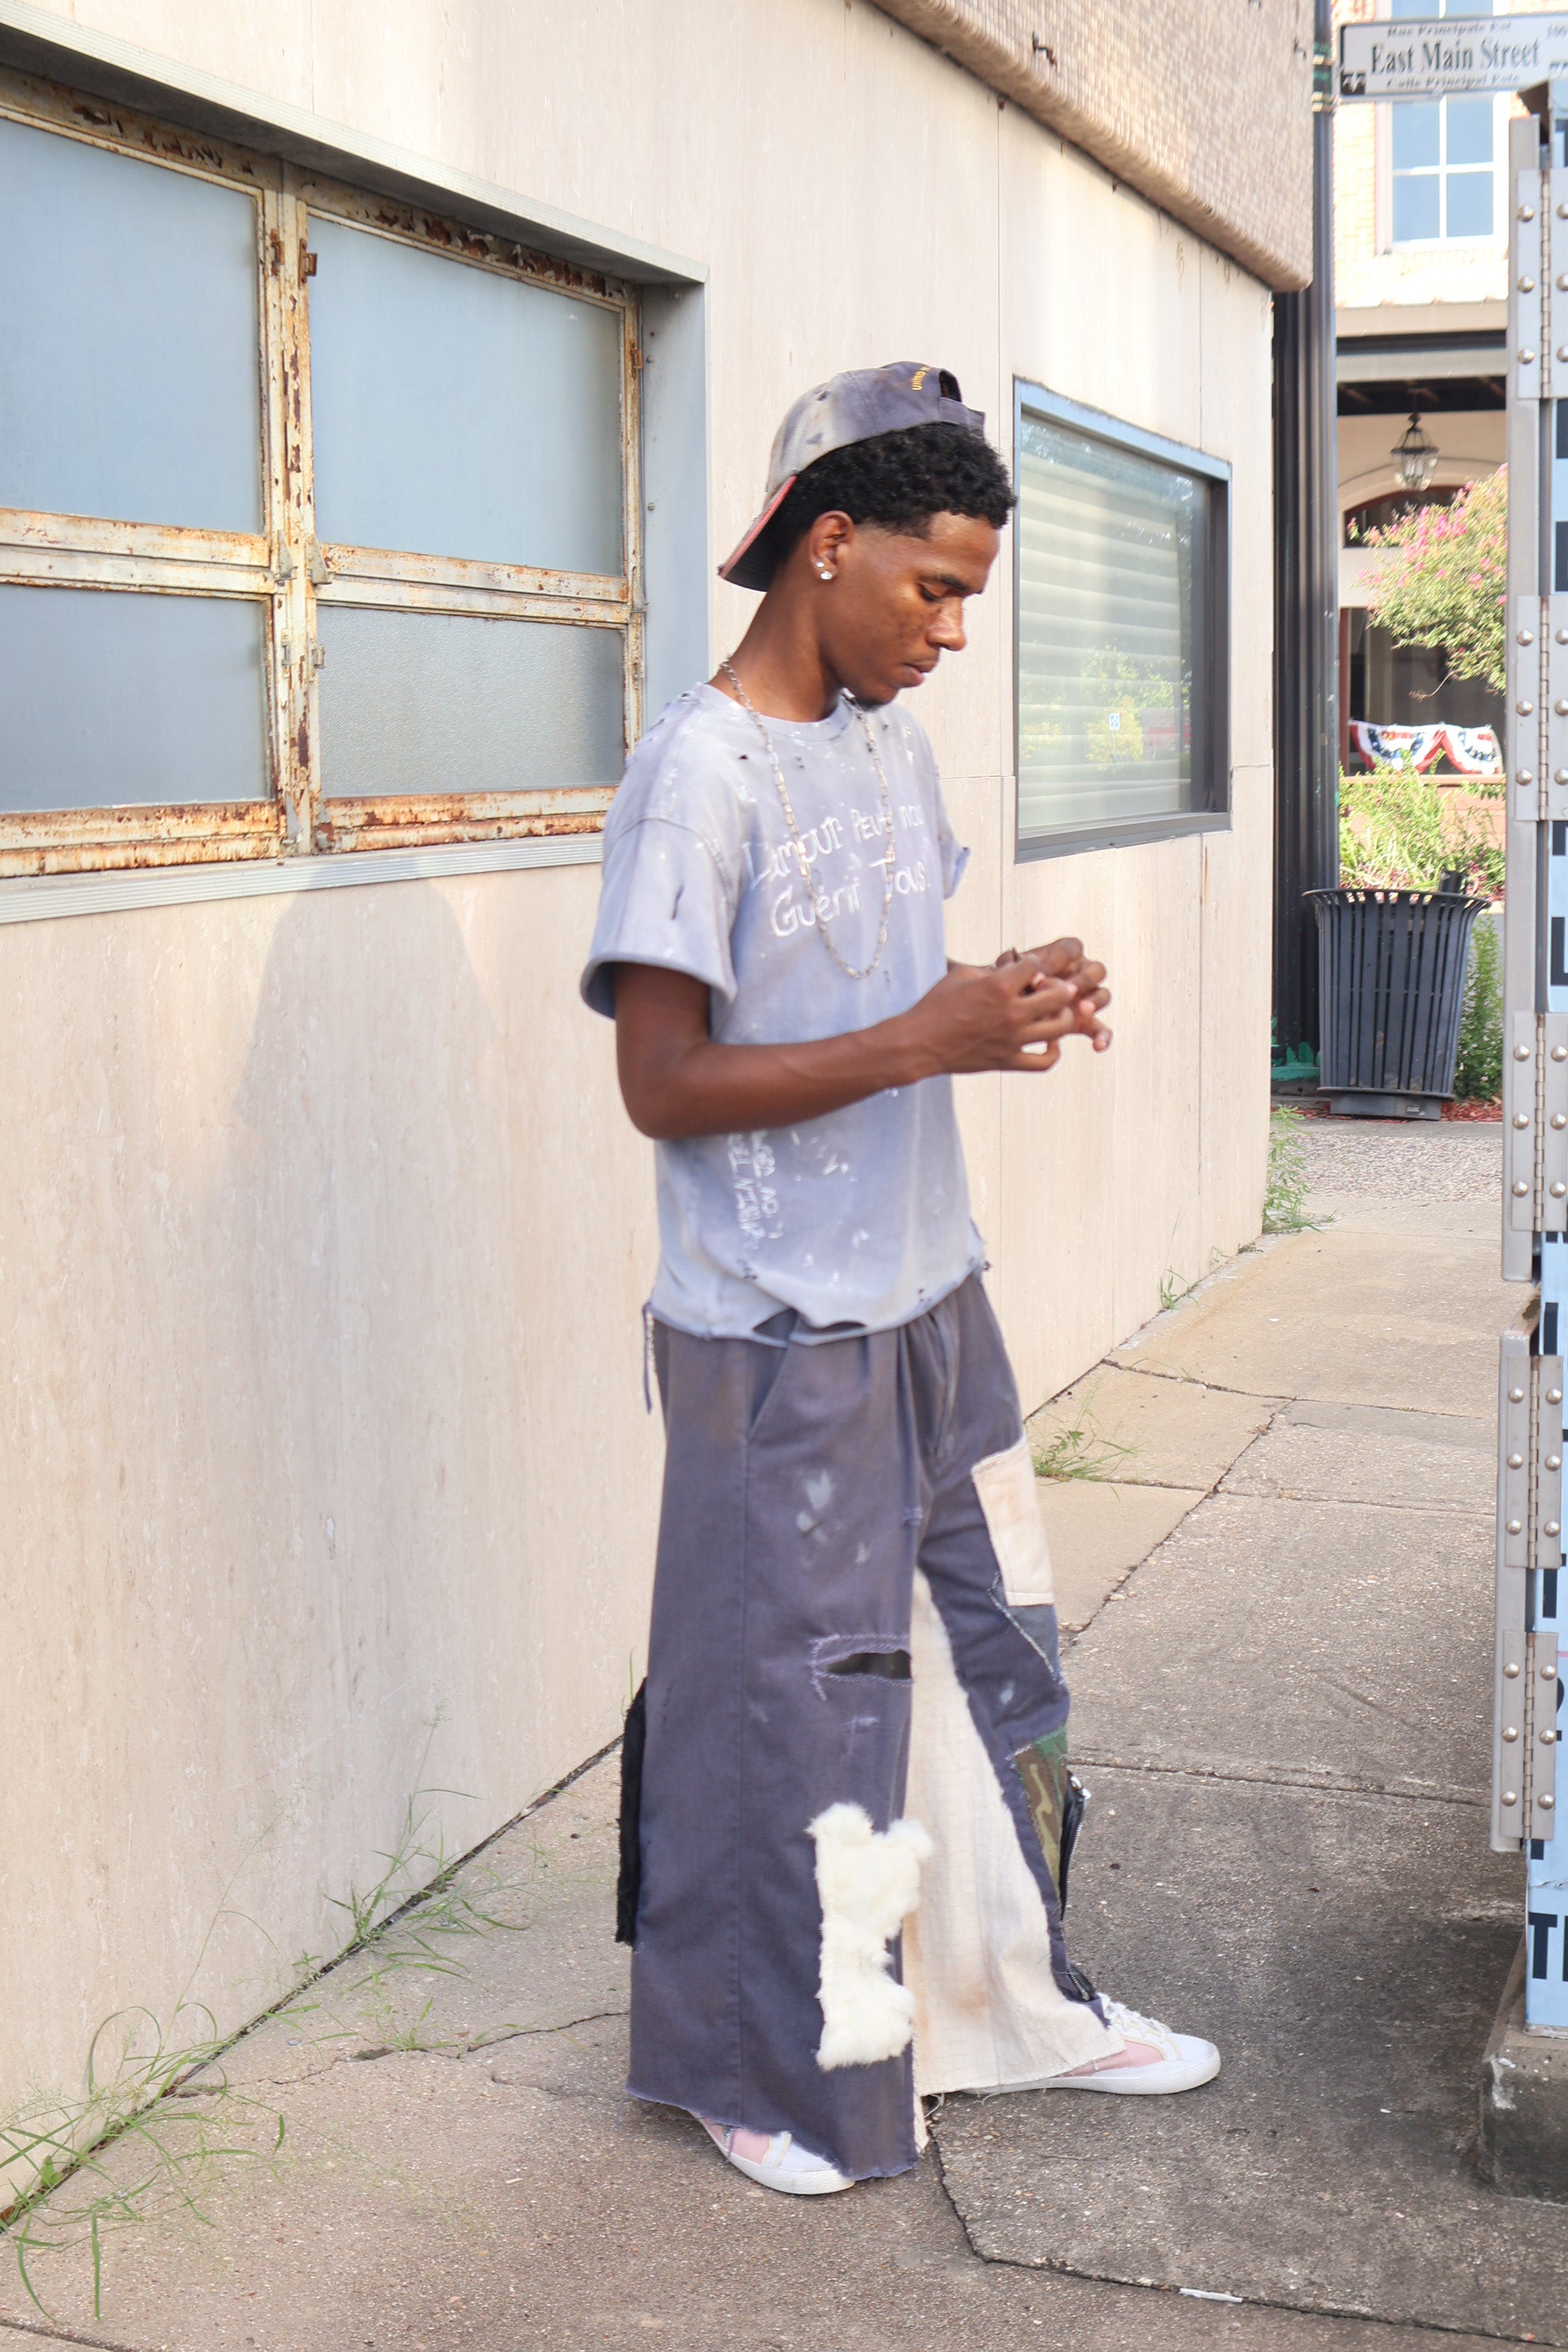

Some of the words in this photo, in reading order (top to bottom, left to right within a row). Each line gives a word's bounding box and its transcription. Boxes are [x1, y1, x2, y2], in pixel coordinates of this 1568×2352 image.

[1372, 42, 1415, 74] East
[1422, 38, 1473, 73] Main
[1480, 36, 1540, 71] Street
